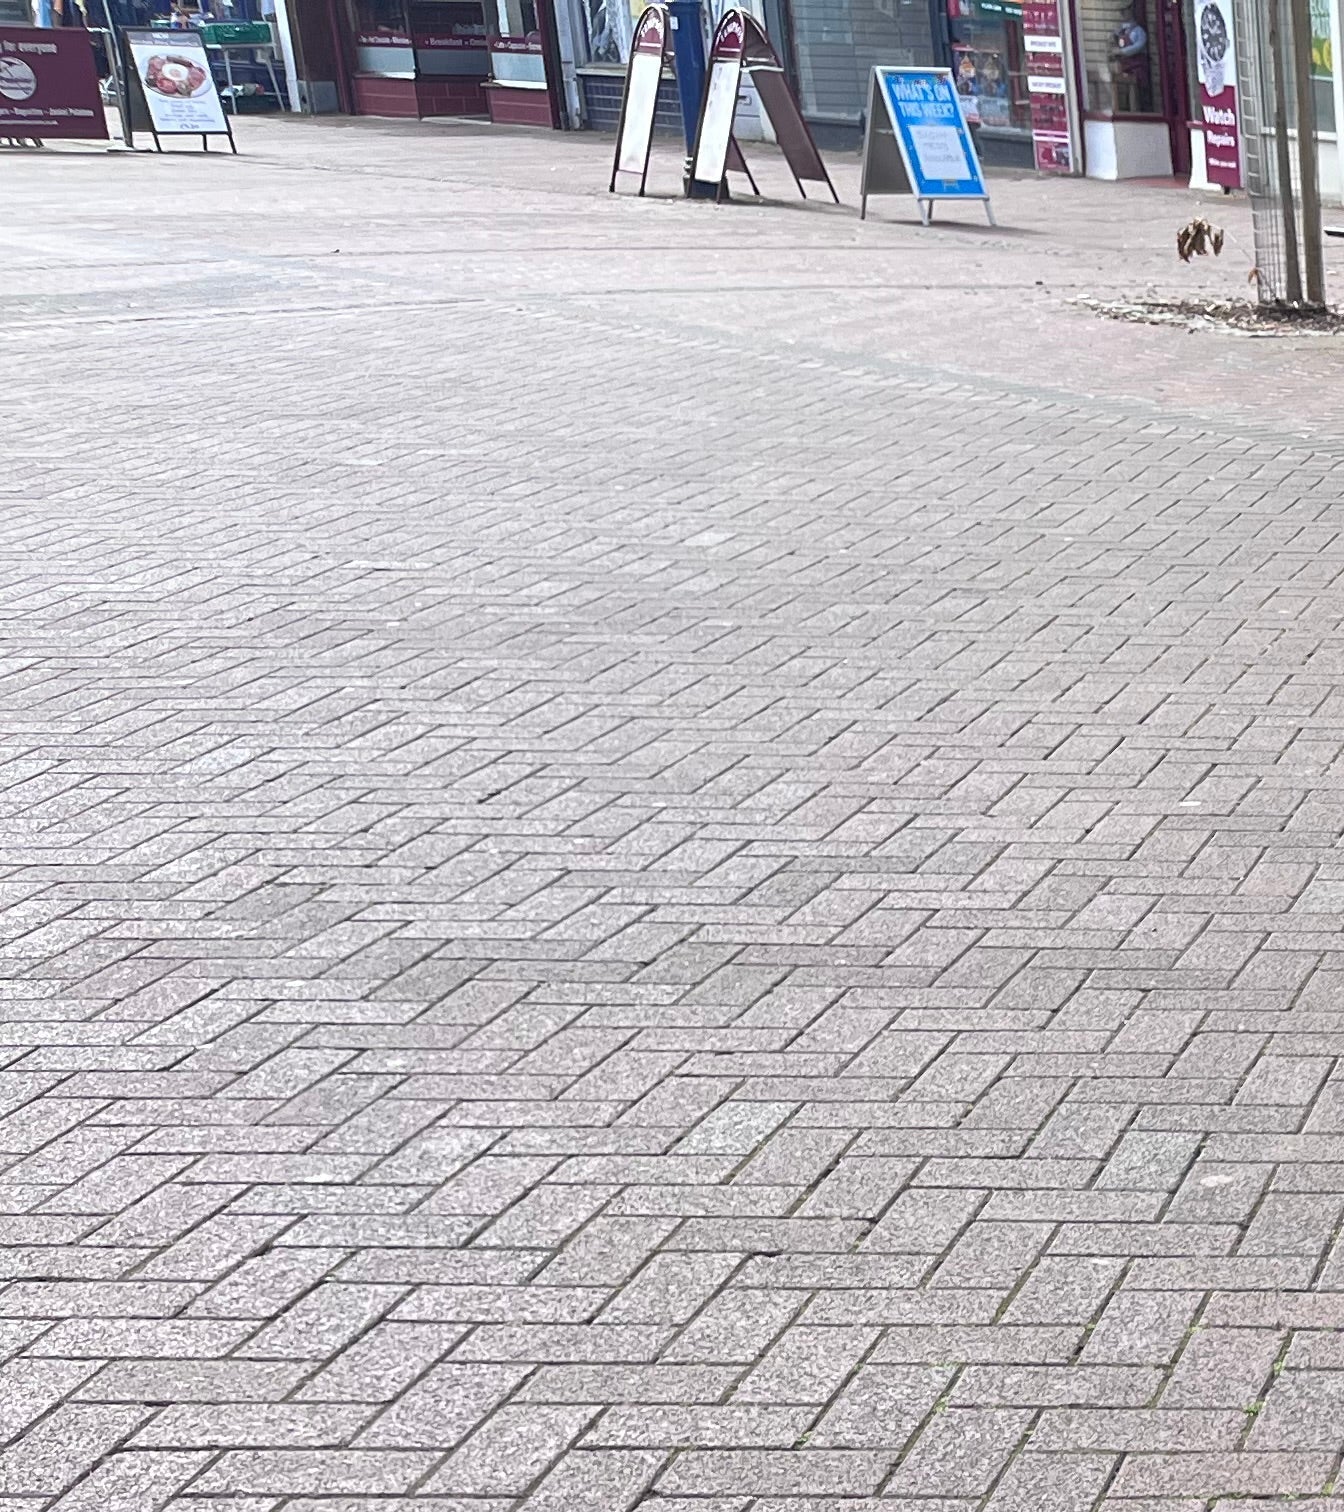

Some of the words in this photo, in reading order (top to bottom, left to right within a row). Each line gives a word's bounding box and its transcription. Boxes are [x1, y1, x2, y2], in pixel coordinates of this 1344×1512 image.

[892, 83, 934, 101] WHAT'S
[933, 84, 952, 101] ON
[898, 101, 922, 118] THIS
[921, 102, 955, 118] WEEK?
[1202, 105, 1235, 126] Watch
[1206, 130, 1236, 148] Repairs
